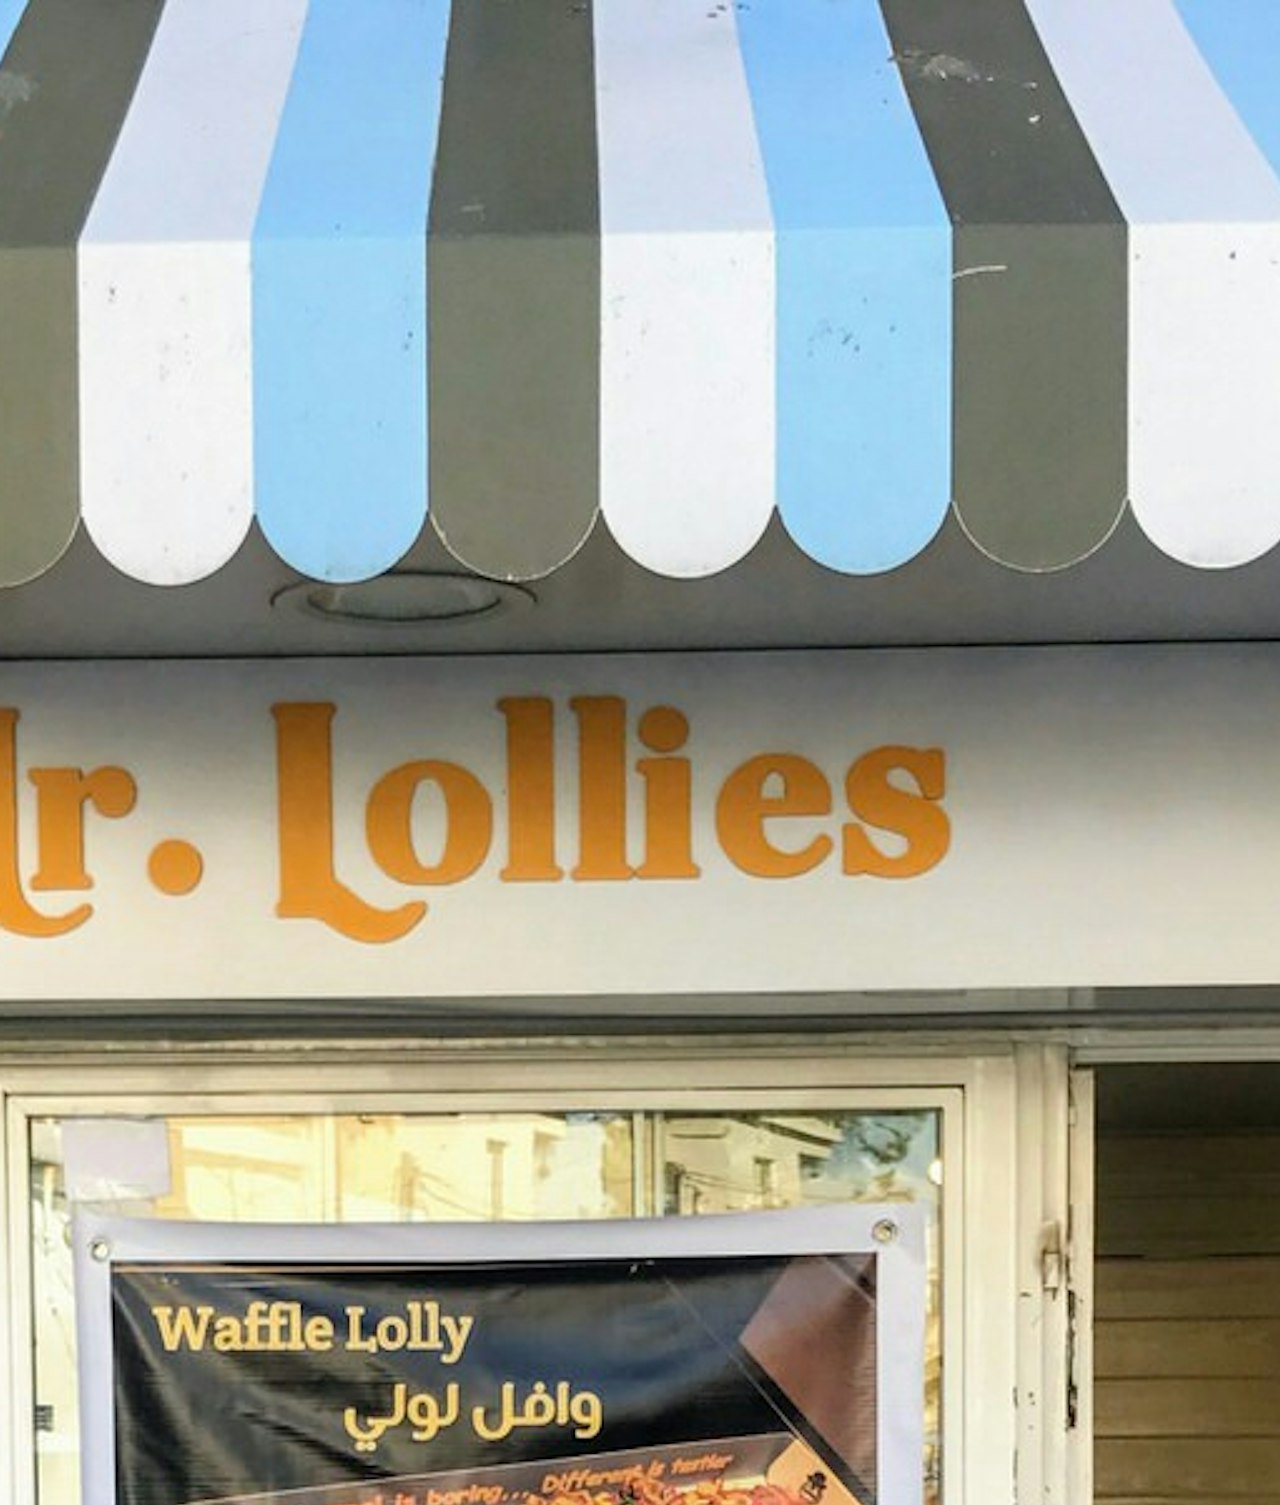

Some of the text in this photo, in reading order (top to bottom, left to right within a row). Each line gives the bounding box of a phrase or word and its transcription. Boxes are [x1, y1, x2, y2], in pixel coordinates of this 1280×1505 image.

[272, 695, 952, 945] Lollies
[152, 1302, 474, 1364] Waffle Lolly
[343, 1380, 604, 1451] وافل لولي
